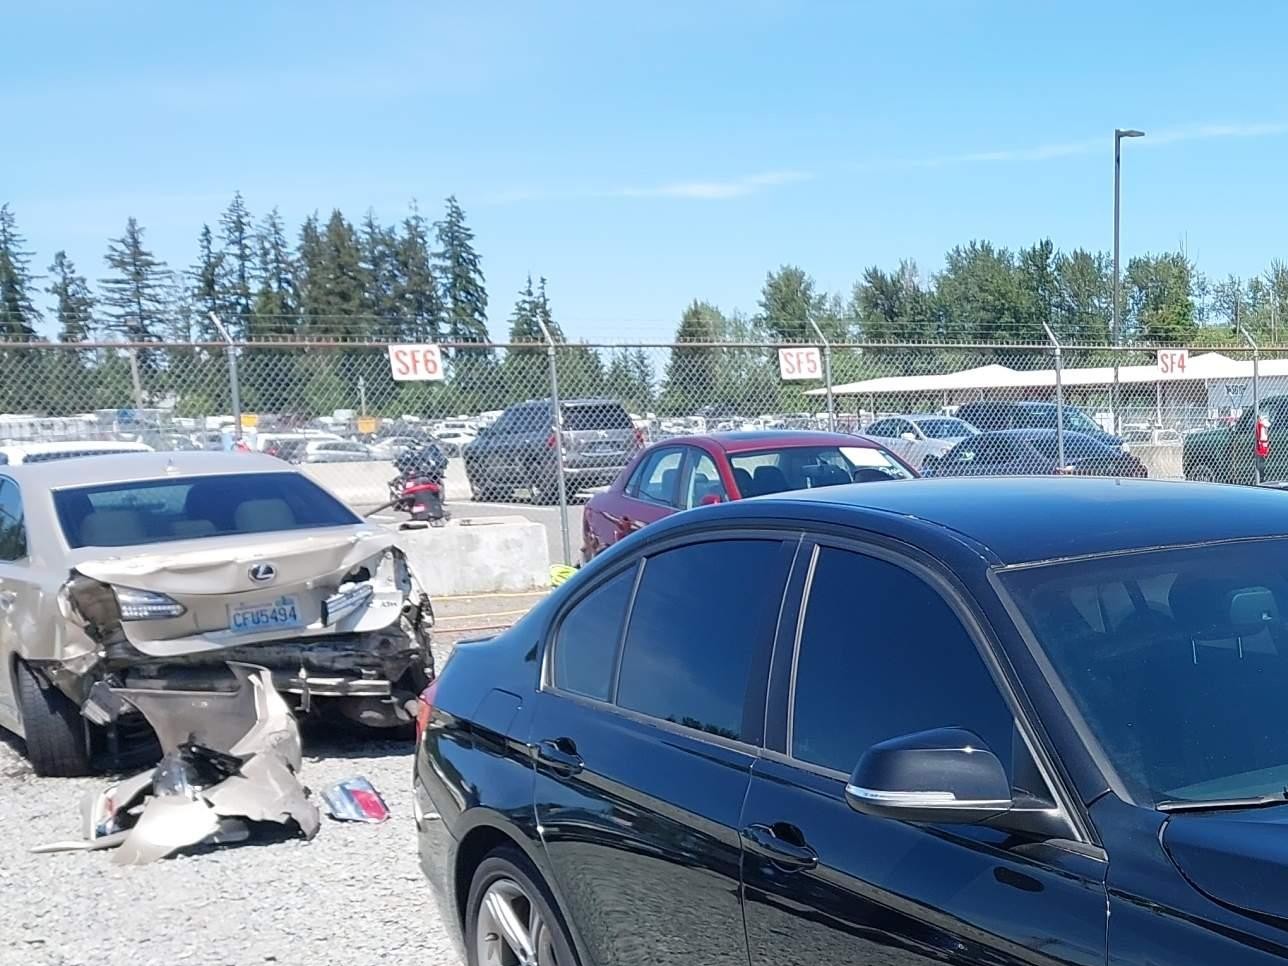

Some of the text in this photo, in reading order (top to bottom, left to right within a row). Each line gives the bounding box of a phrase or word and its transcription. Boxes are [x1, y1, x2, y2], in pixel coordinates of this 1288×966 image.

[394, 349, 438, 375] SF6
[783, 351, 817, 374] SF5
[1160, 353, 1186, 374] SF4
[232, 605, 297, 629] CFU5494
